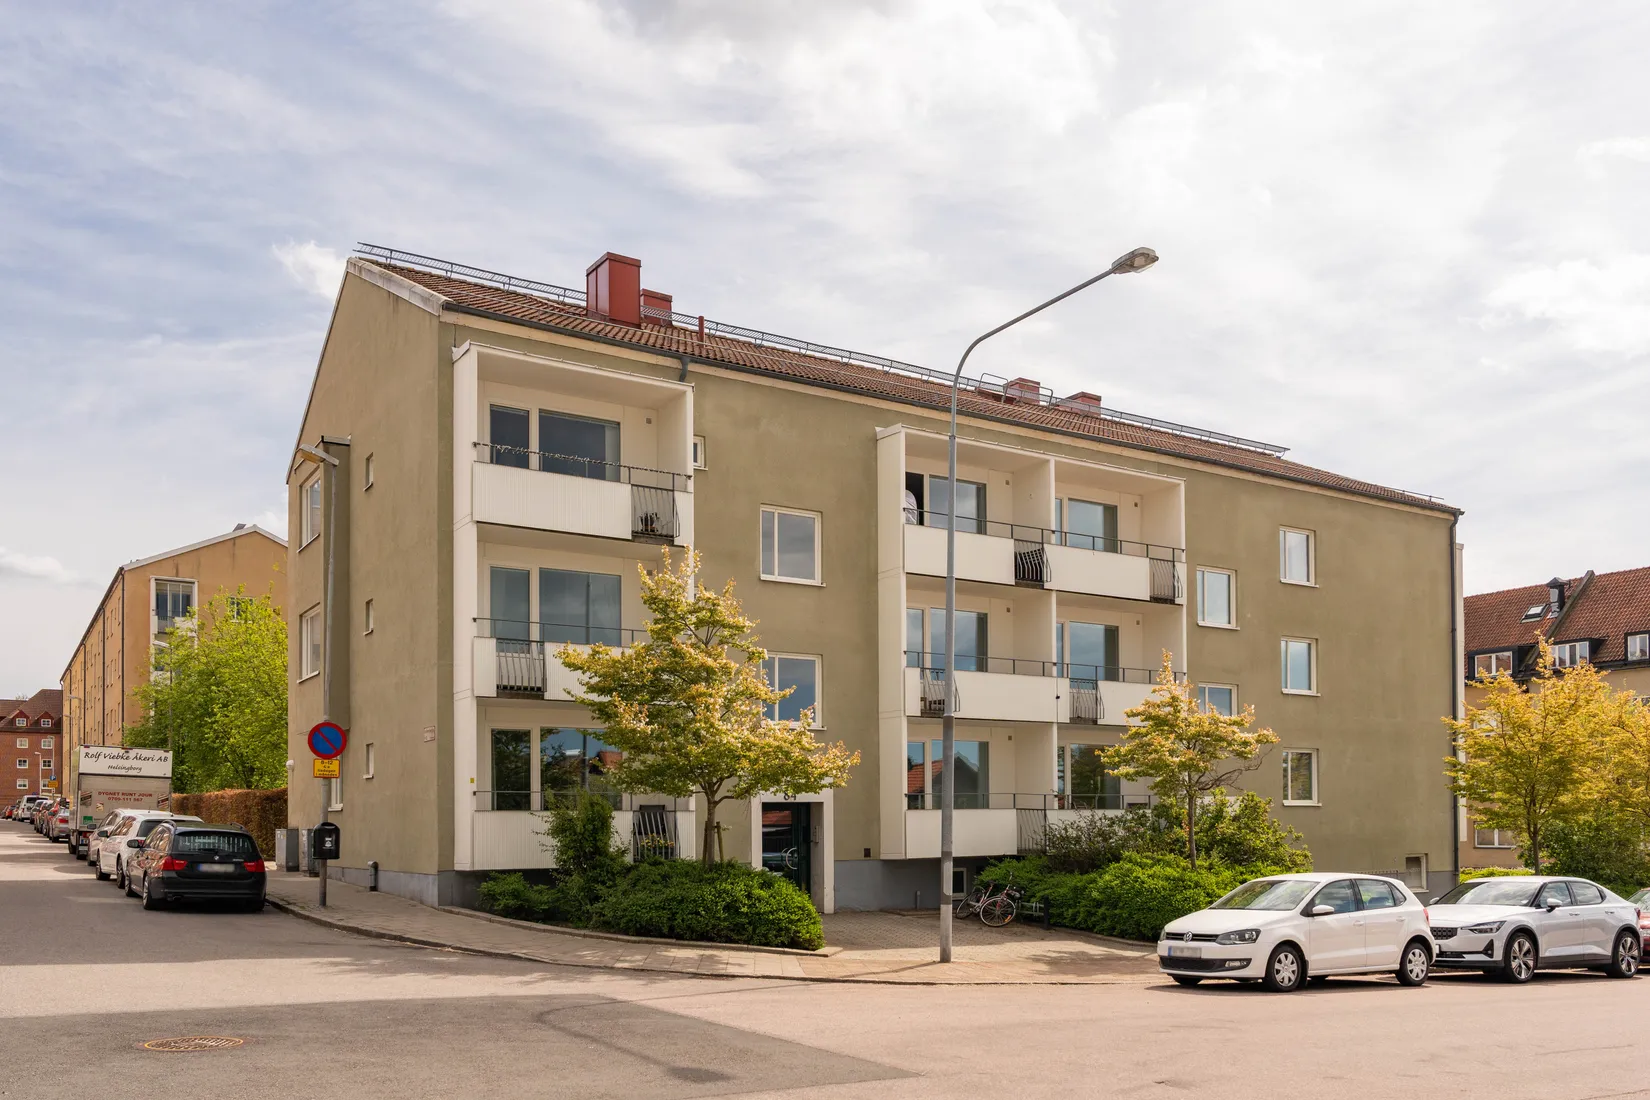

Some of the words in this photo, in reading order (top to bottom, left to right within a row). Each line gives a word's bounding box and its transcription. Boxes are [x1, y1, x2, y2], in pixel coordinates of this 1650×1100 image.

[84, 752, 102, 762] Rolf
[132, 753, 155, 762] Åkeri
[108, 765, 142, 773] Helsingborg
